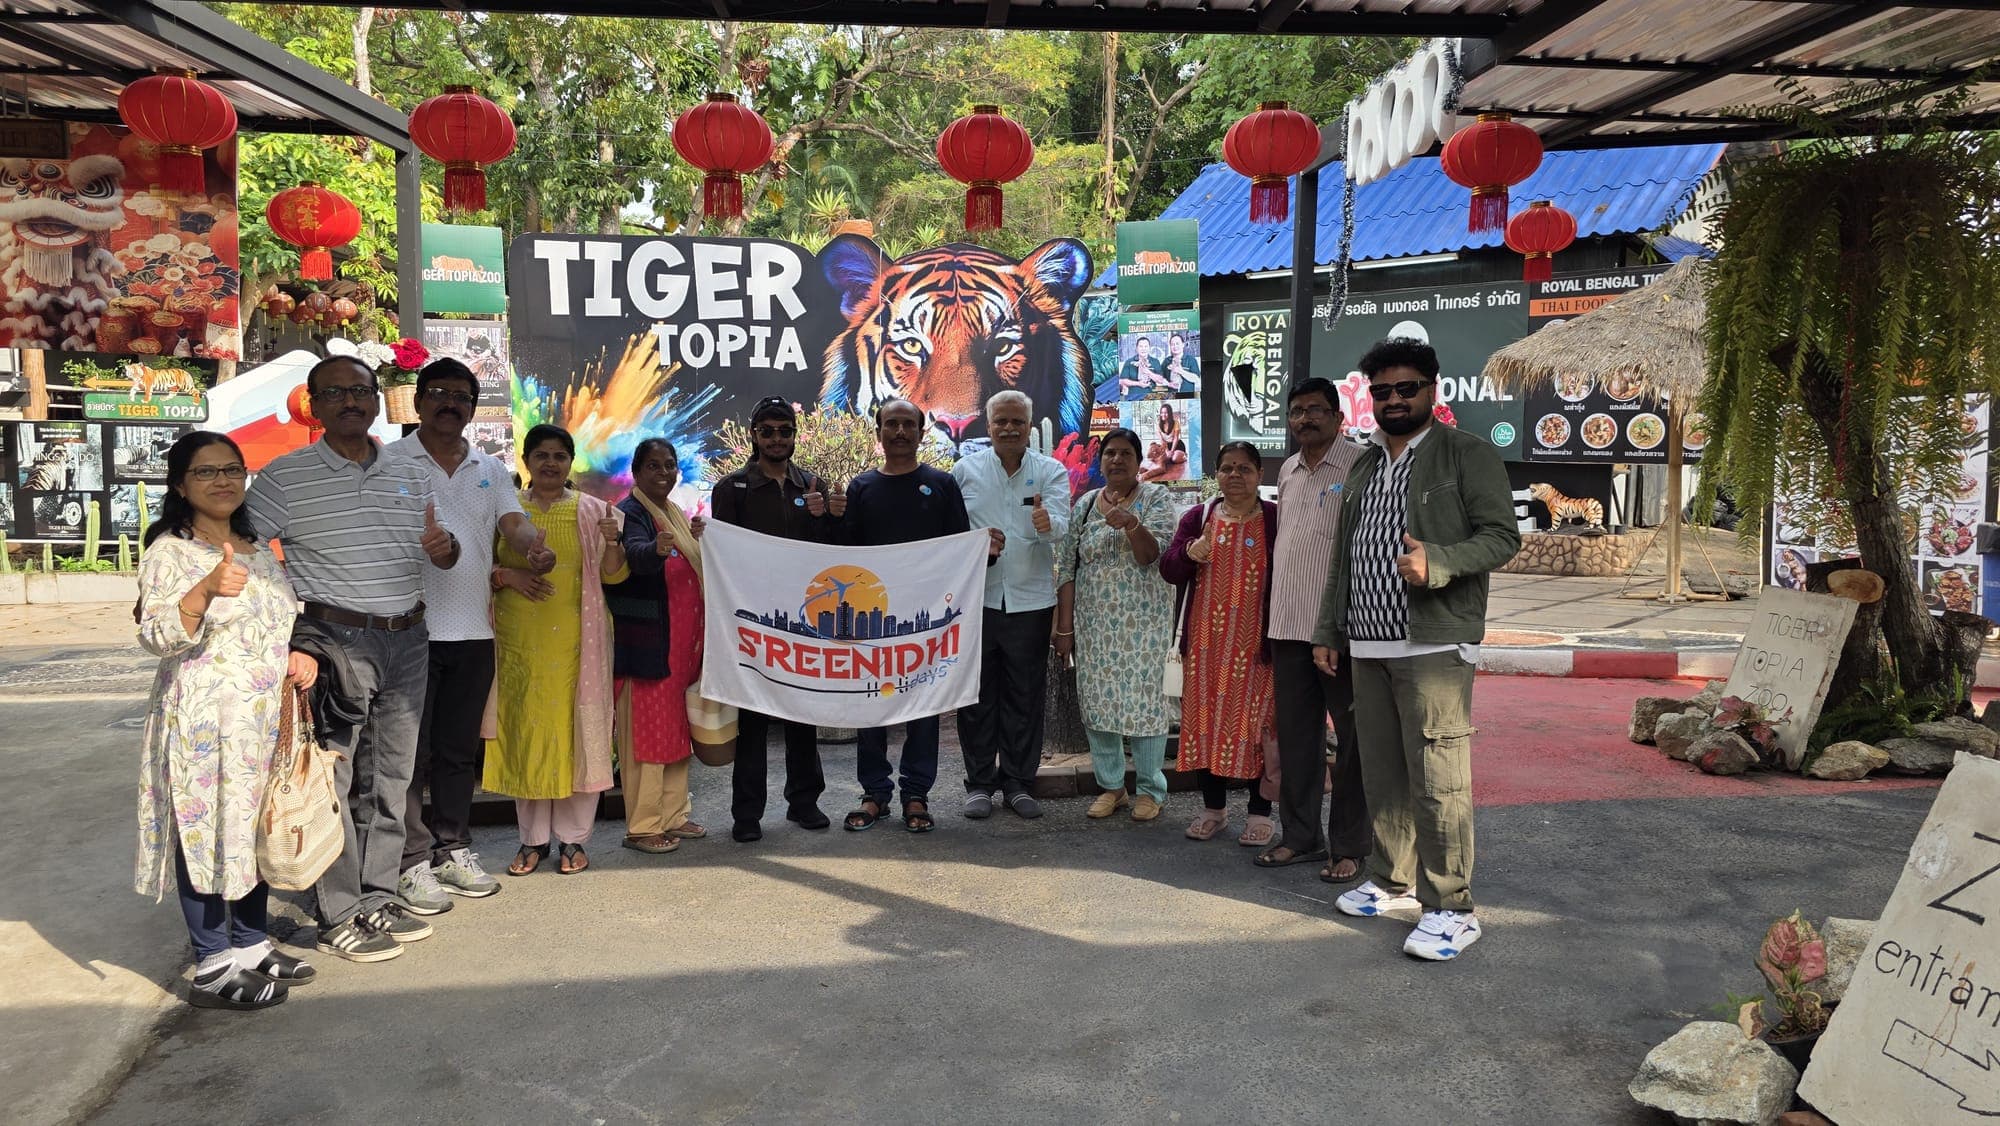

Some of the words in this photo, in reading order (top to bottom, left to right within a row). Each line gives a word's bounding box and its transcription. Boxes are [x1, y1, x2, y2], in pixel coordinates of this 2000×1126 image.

[421, 268, 445, 281] IGER
[448, 269, 479, 282] TOPIA
[480, 271, 501, 284] ZOO
[534, 239, 807, 321] TIGER
[1118, 263, 1146, 277] TIGER
[1148, 261, 1175, 275] TOPIA
[1177, 261, 1196, 273] ZOO
[1541, 279, 1582, 294] ROYAL
[1585, 275, 1639, 291] BENGAL
[1383, 298, 1429, 314] เบงกอล
[1434, 292, 1481, 311] ไทเกอร์
[1541, 301, 1569, 313] THAI
[1236, 312, 1291, 331] ROYA
[651, 323, 808, 373] TOPIA
[1265, 332, 1283, 426] BENGAL
[119, 404, 159, 417] TIGER
[163, 405, 205, 418] TOPIA
[1767, 612, 1819, 642] TIGER
[738, 623, 960, 680] SREENIDHI
[1743, 646, 1804, 681] TOPIA
[1743, 685, 1788, 712] ZOO
